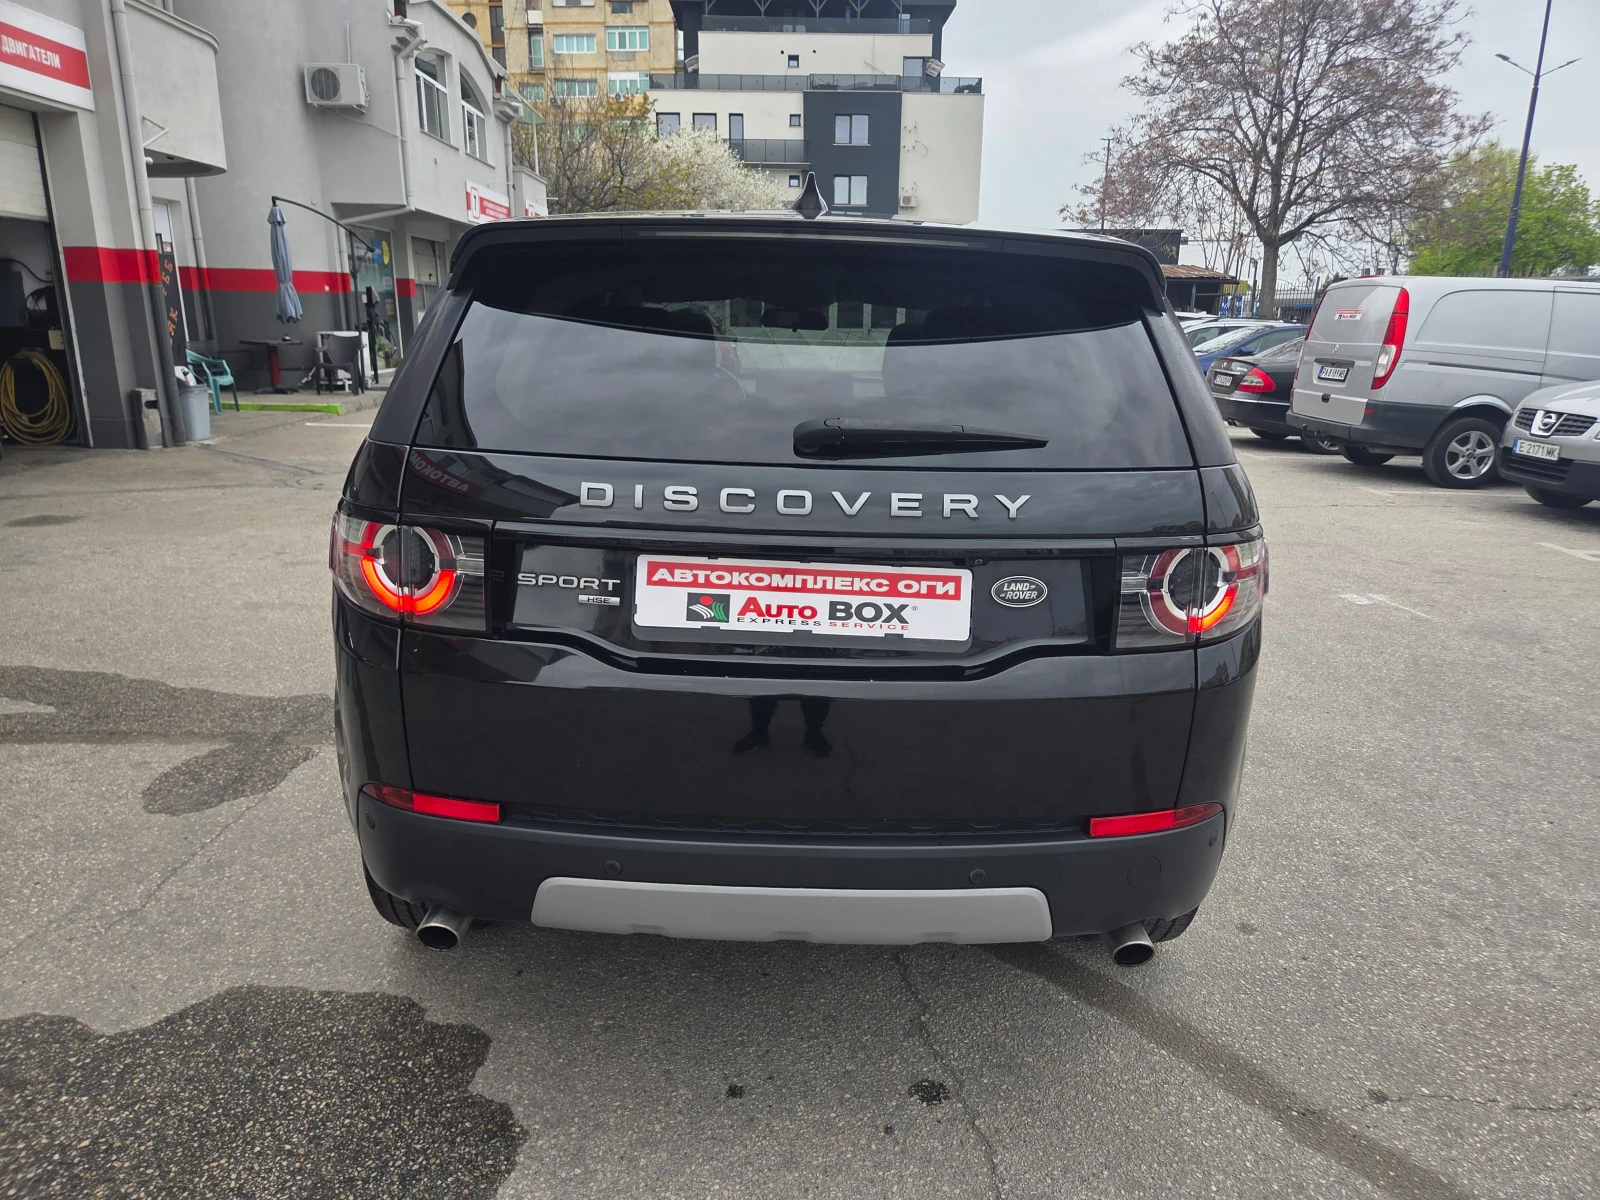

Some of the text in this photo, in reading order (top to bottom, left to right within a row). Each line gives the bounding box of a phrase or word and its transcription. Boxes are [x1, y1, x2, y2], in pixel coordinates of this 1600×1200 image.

[1, 34, 61, 69] ДВИГАТЕЛИ
[580, 481, 1032, 519] DISCOVERY
[517, 572, 621, 591] SPORT
[651, 568, 956, 596] АВТОКОМПЛЕКС ОГИ
[1003, 582, 1030, 591] LAND
[587, 596, 611, 605] HSE
[1005, 591, 1038, 600] ROVER
[828, 600, 910, 625] BOX
[737, 617, 910, 631] EXPRESS SERVICE
